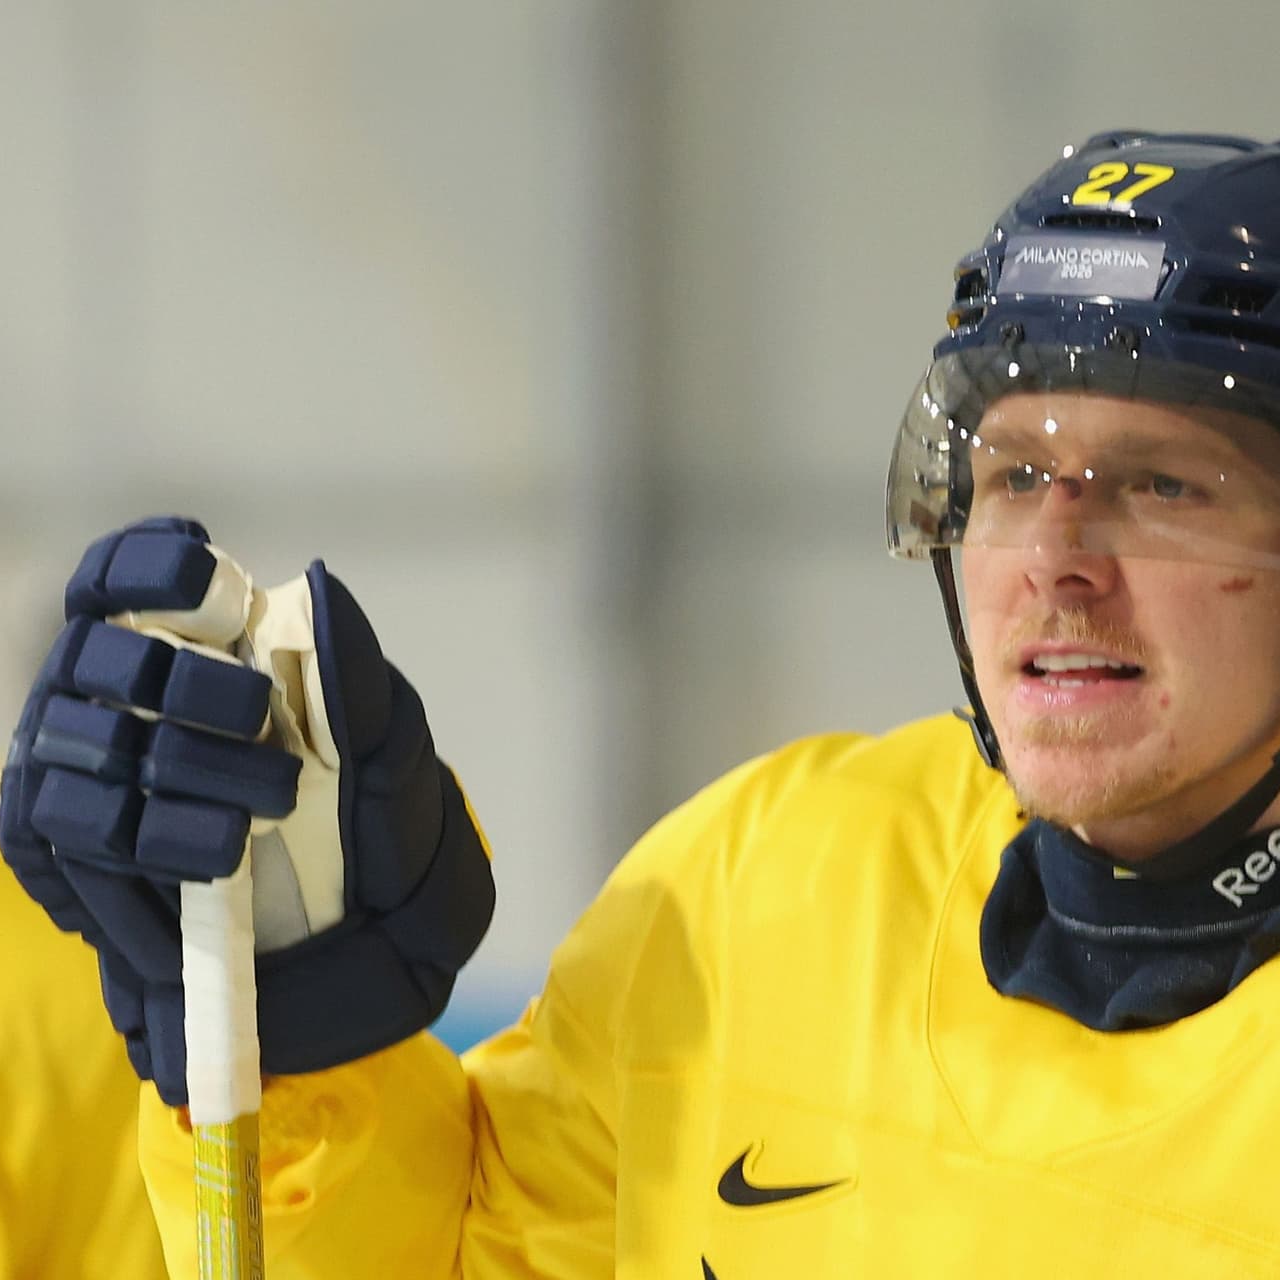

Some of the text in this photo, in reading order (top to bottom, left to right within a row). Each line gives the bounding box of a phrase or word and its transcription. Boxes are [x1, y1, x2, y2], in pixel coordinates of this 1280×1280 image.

[1073, 162, 1175, 207] 27
[1015, 246, 1149, 269] MILANO CORTINA
[1061, 263, 1093, 279] 2026
